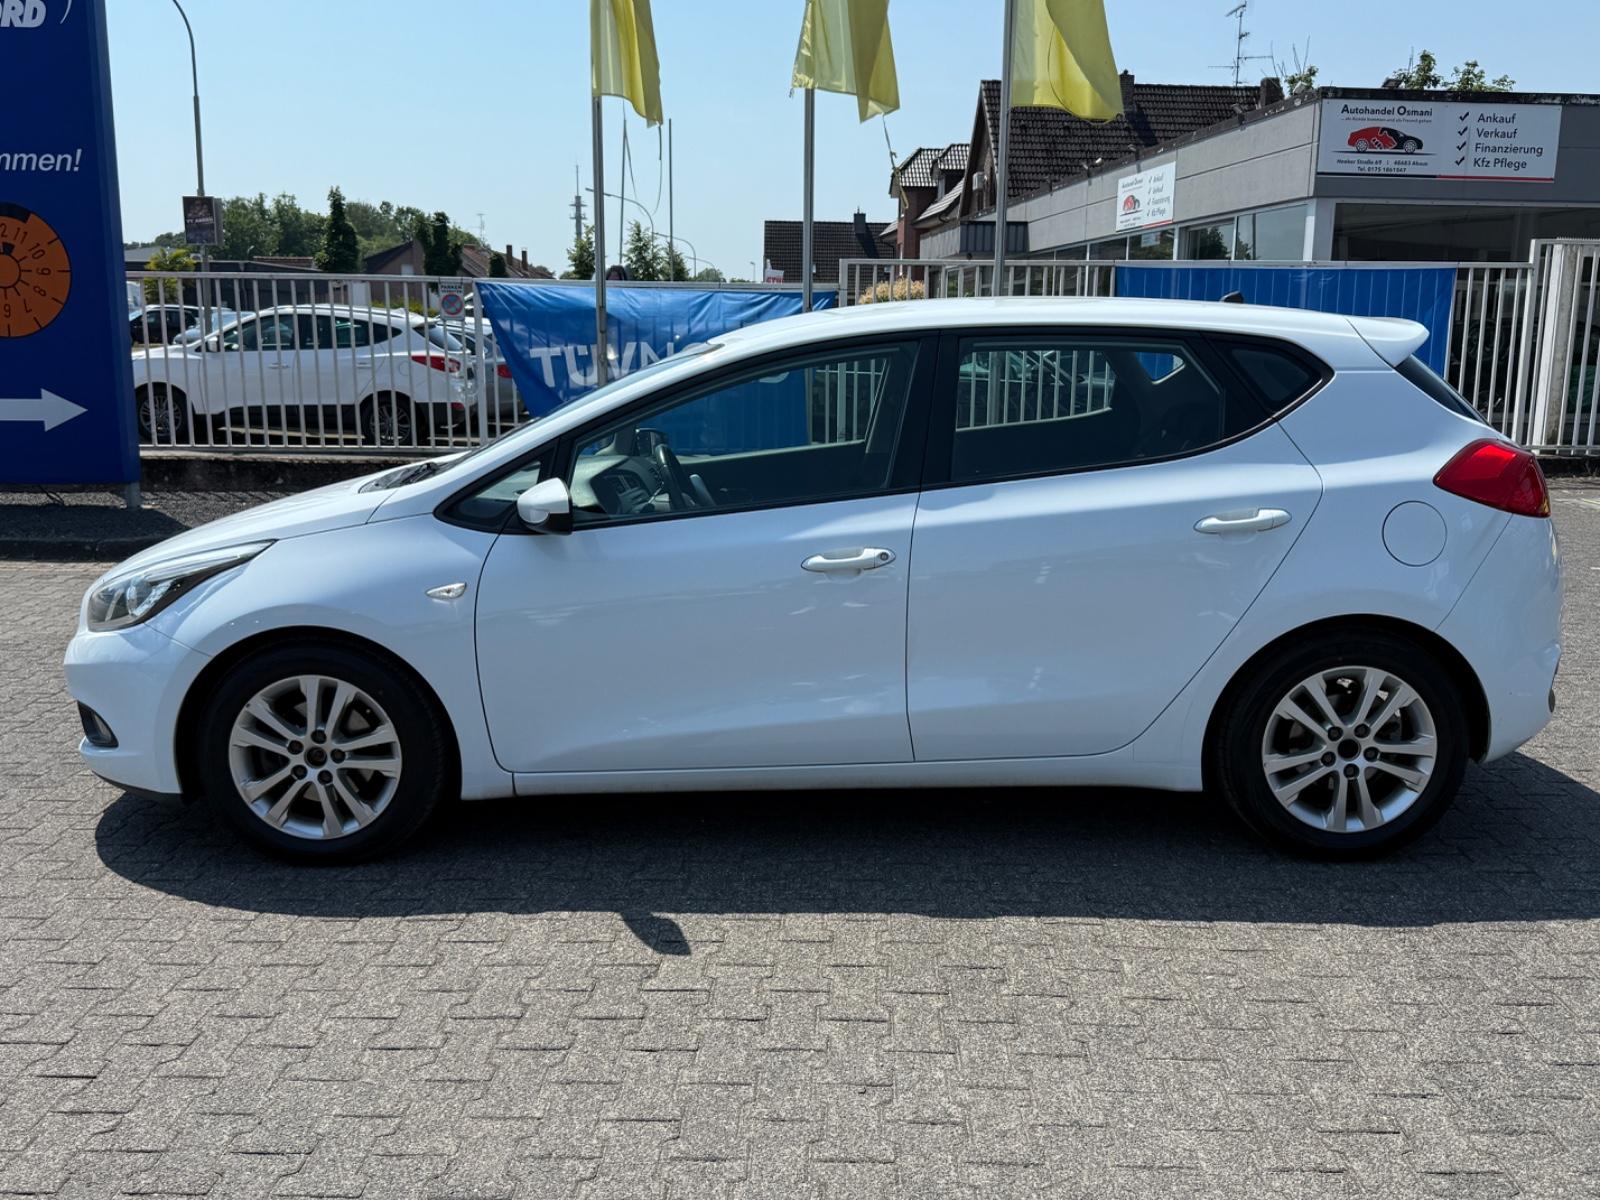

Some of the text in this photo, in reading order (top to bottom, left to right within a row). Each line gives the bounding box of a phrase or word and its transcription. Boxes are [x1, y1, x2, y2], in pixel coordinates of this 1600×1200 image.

[0, 0, 47, 28] RD
[1341, 104, 1433, 117] Autohandel Osmani
[1477, 113, 1517, 124] Ankauf
[1476, 128, 1518, 139] Verkauf
[1475, 142, 1544, 158] Finanzierung
[1473, 157, 1528, 171] Kfz Pflege
[28, 242, 46, 260] 10
[32, 285, 47, 297] 8
